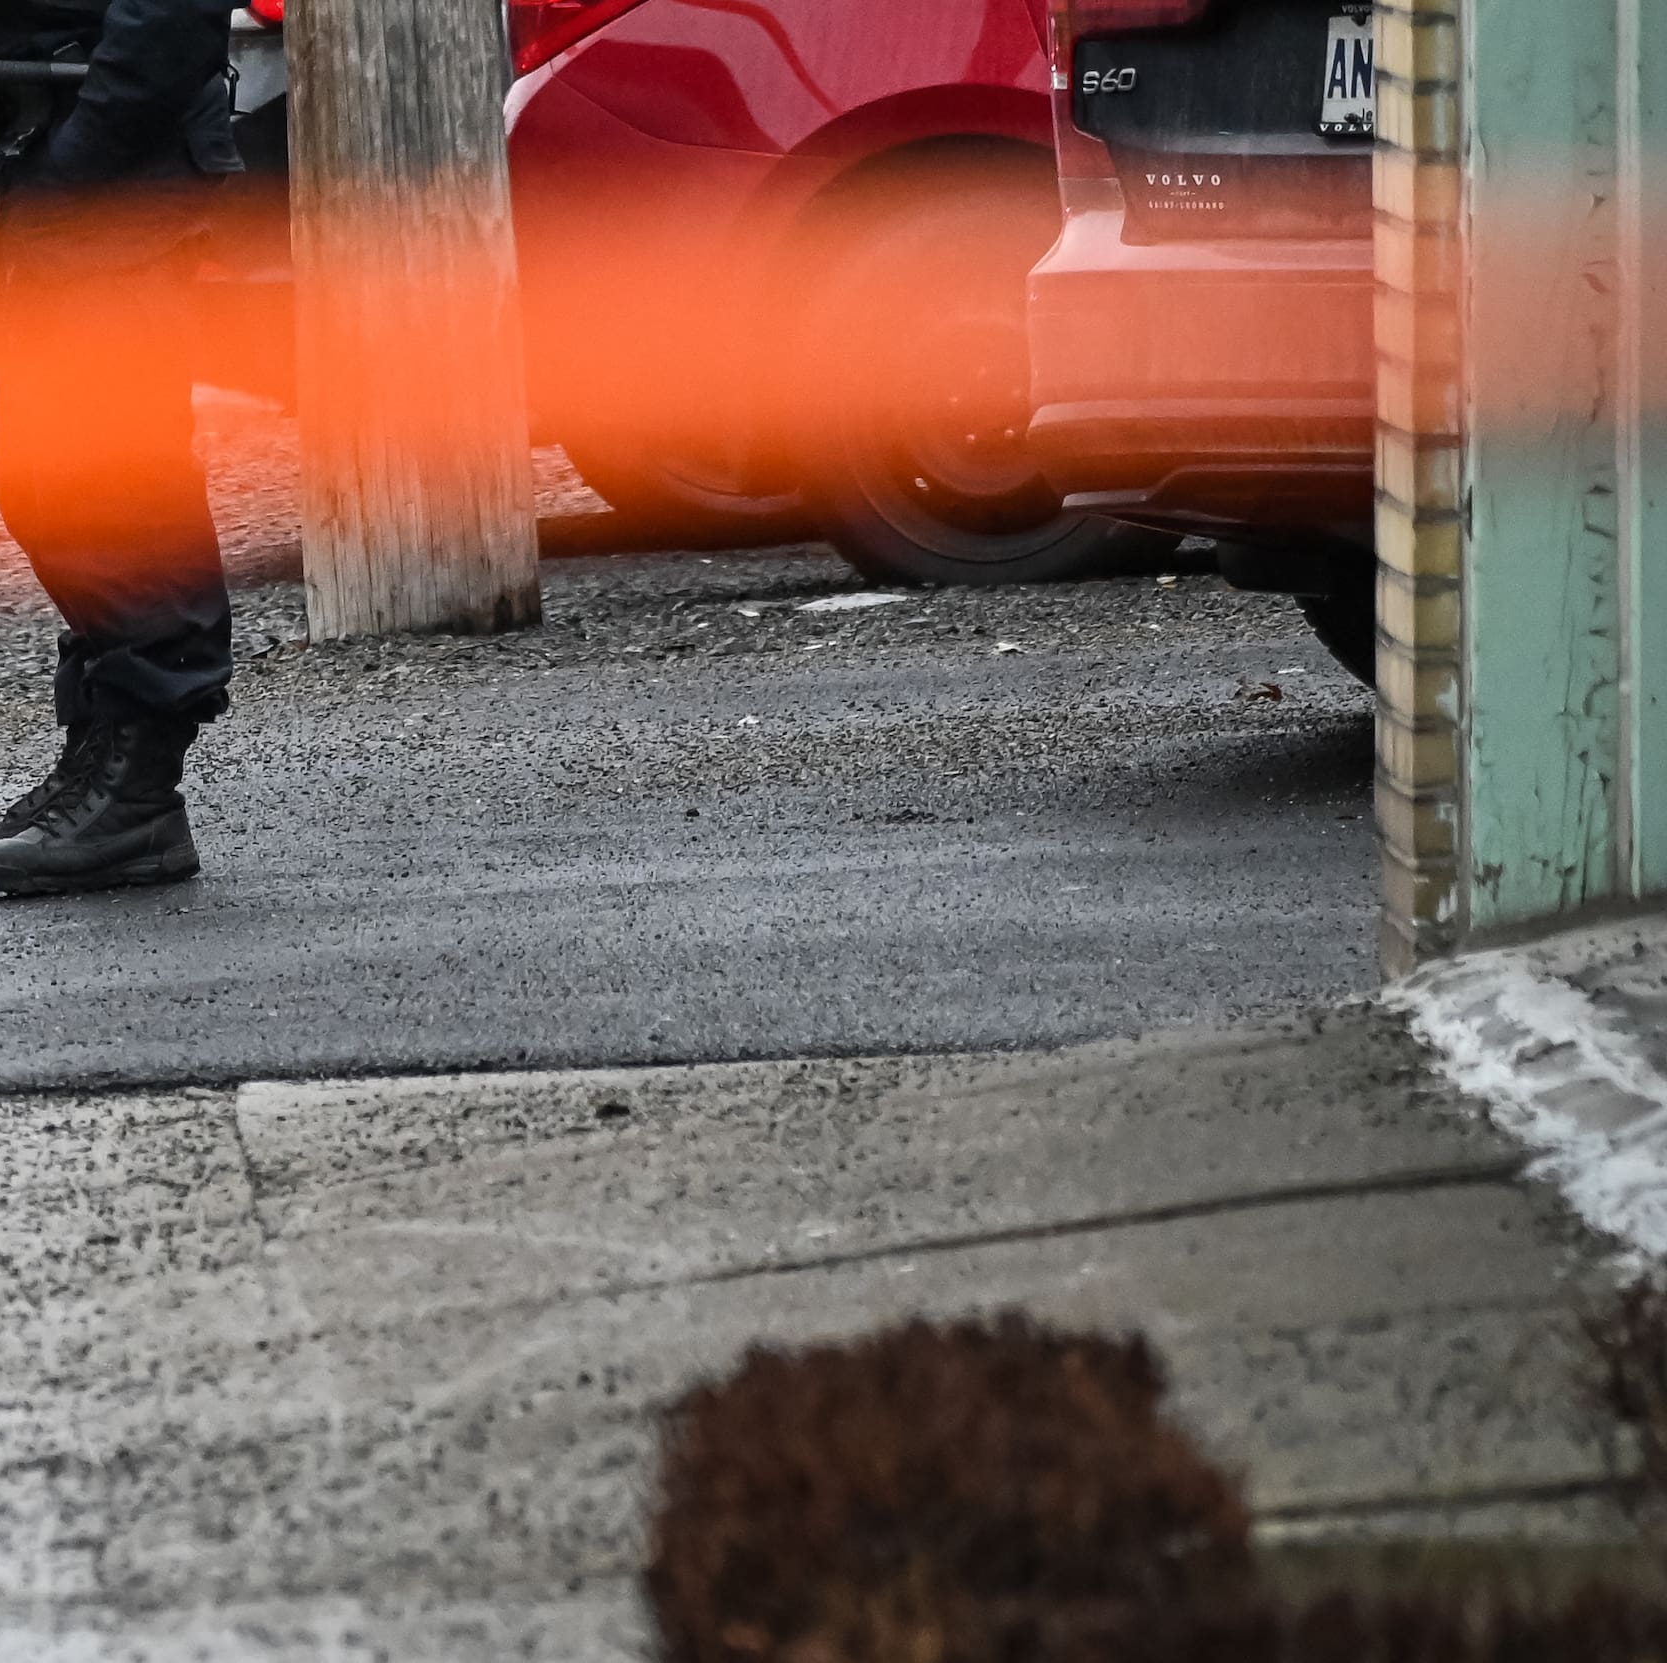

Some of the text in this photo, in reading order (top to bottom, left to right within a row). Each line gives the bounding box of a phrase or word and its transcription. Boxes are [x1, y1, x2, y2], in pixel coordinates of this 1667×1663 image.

[1082, 67, 1136, 94] S60
[1319, 123, 1373, 133] VOLV
[1145, 174, 1222, 187] VOLVO
